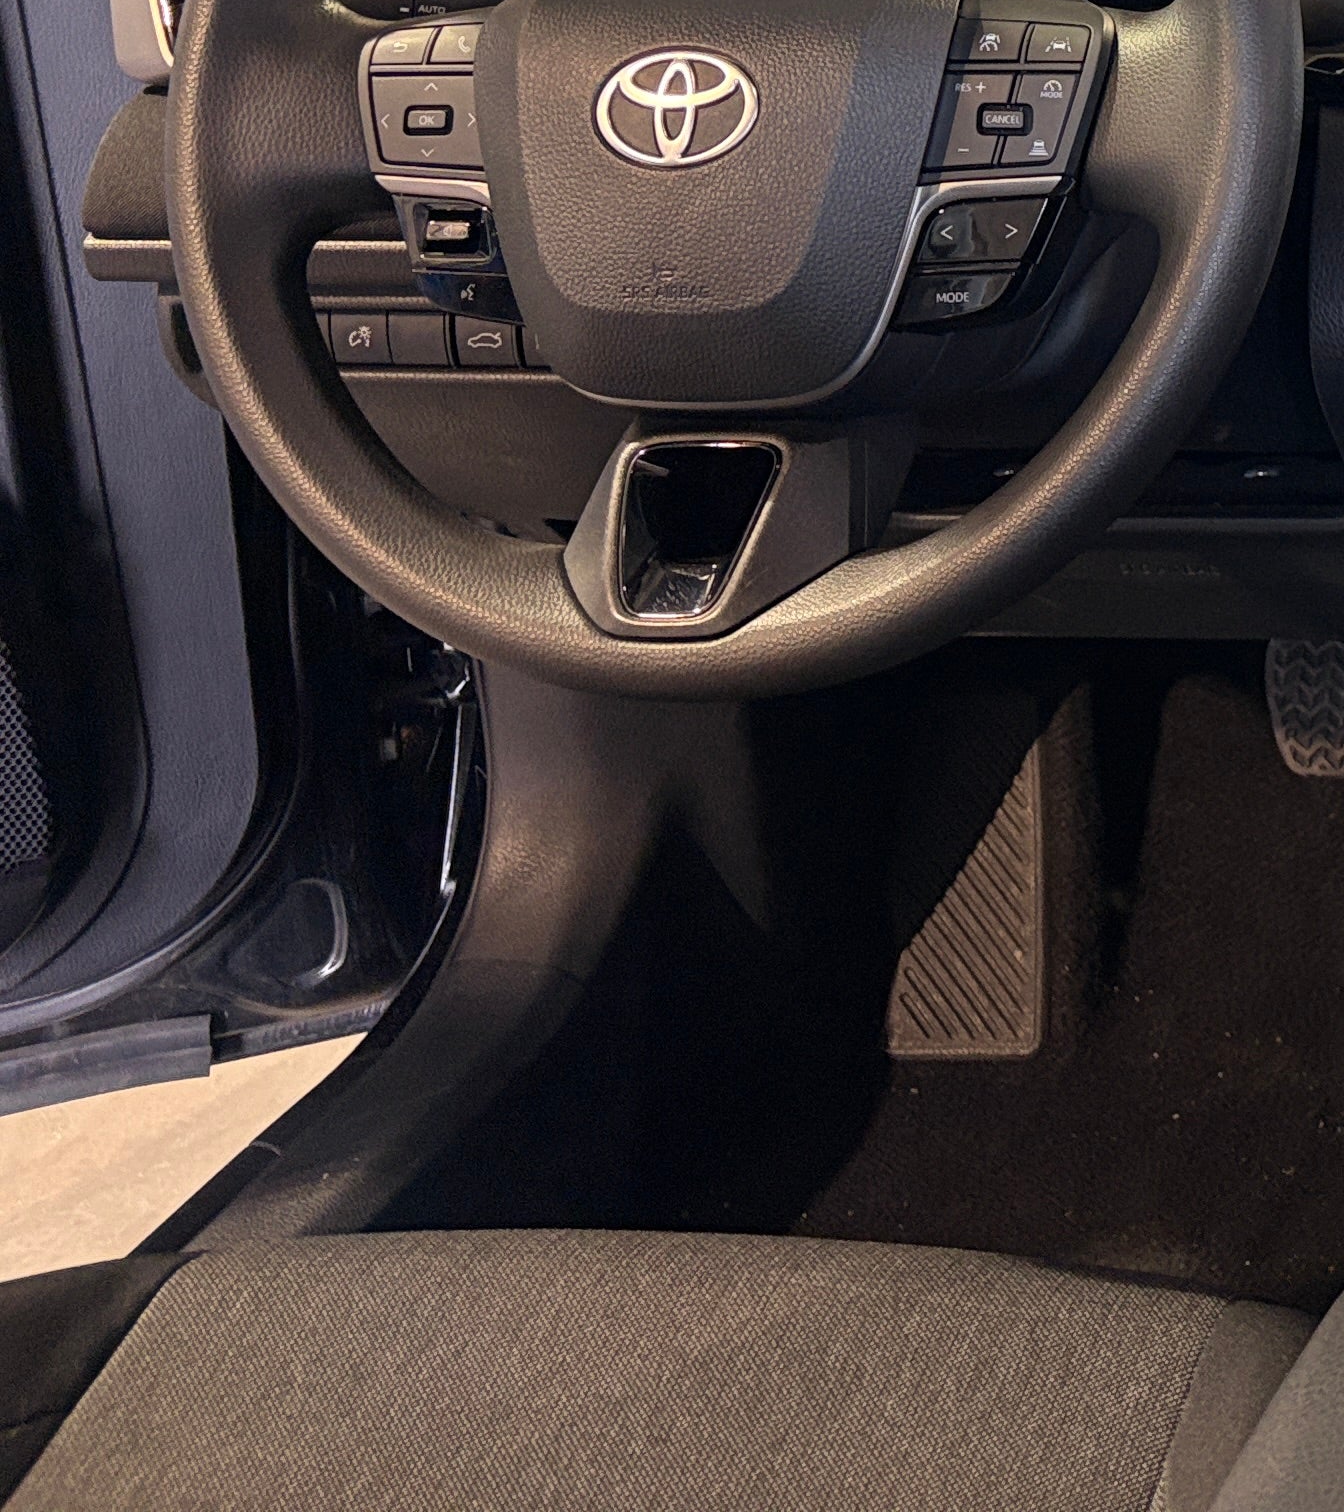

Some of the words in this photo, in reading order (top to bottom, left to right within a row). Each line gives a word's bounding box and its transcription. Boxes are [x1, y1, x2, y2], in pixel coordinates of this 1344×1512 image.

[418, 4, 447, 14] AUTO
[955, 83, 972, 92] RES
[1040, 91, 1063, 99] MODE
[418, 115, 435, 126] OK
[985, 114, 1020, 125] CANCEL
[935, 291, 970, 304] MODE
